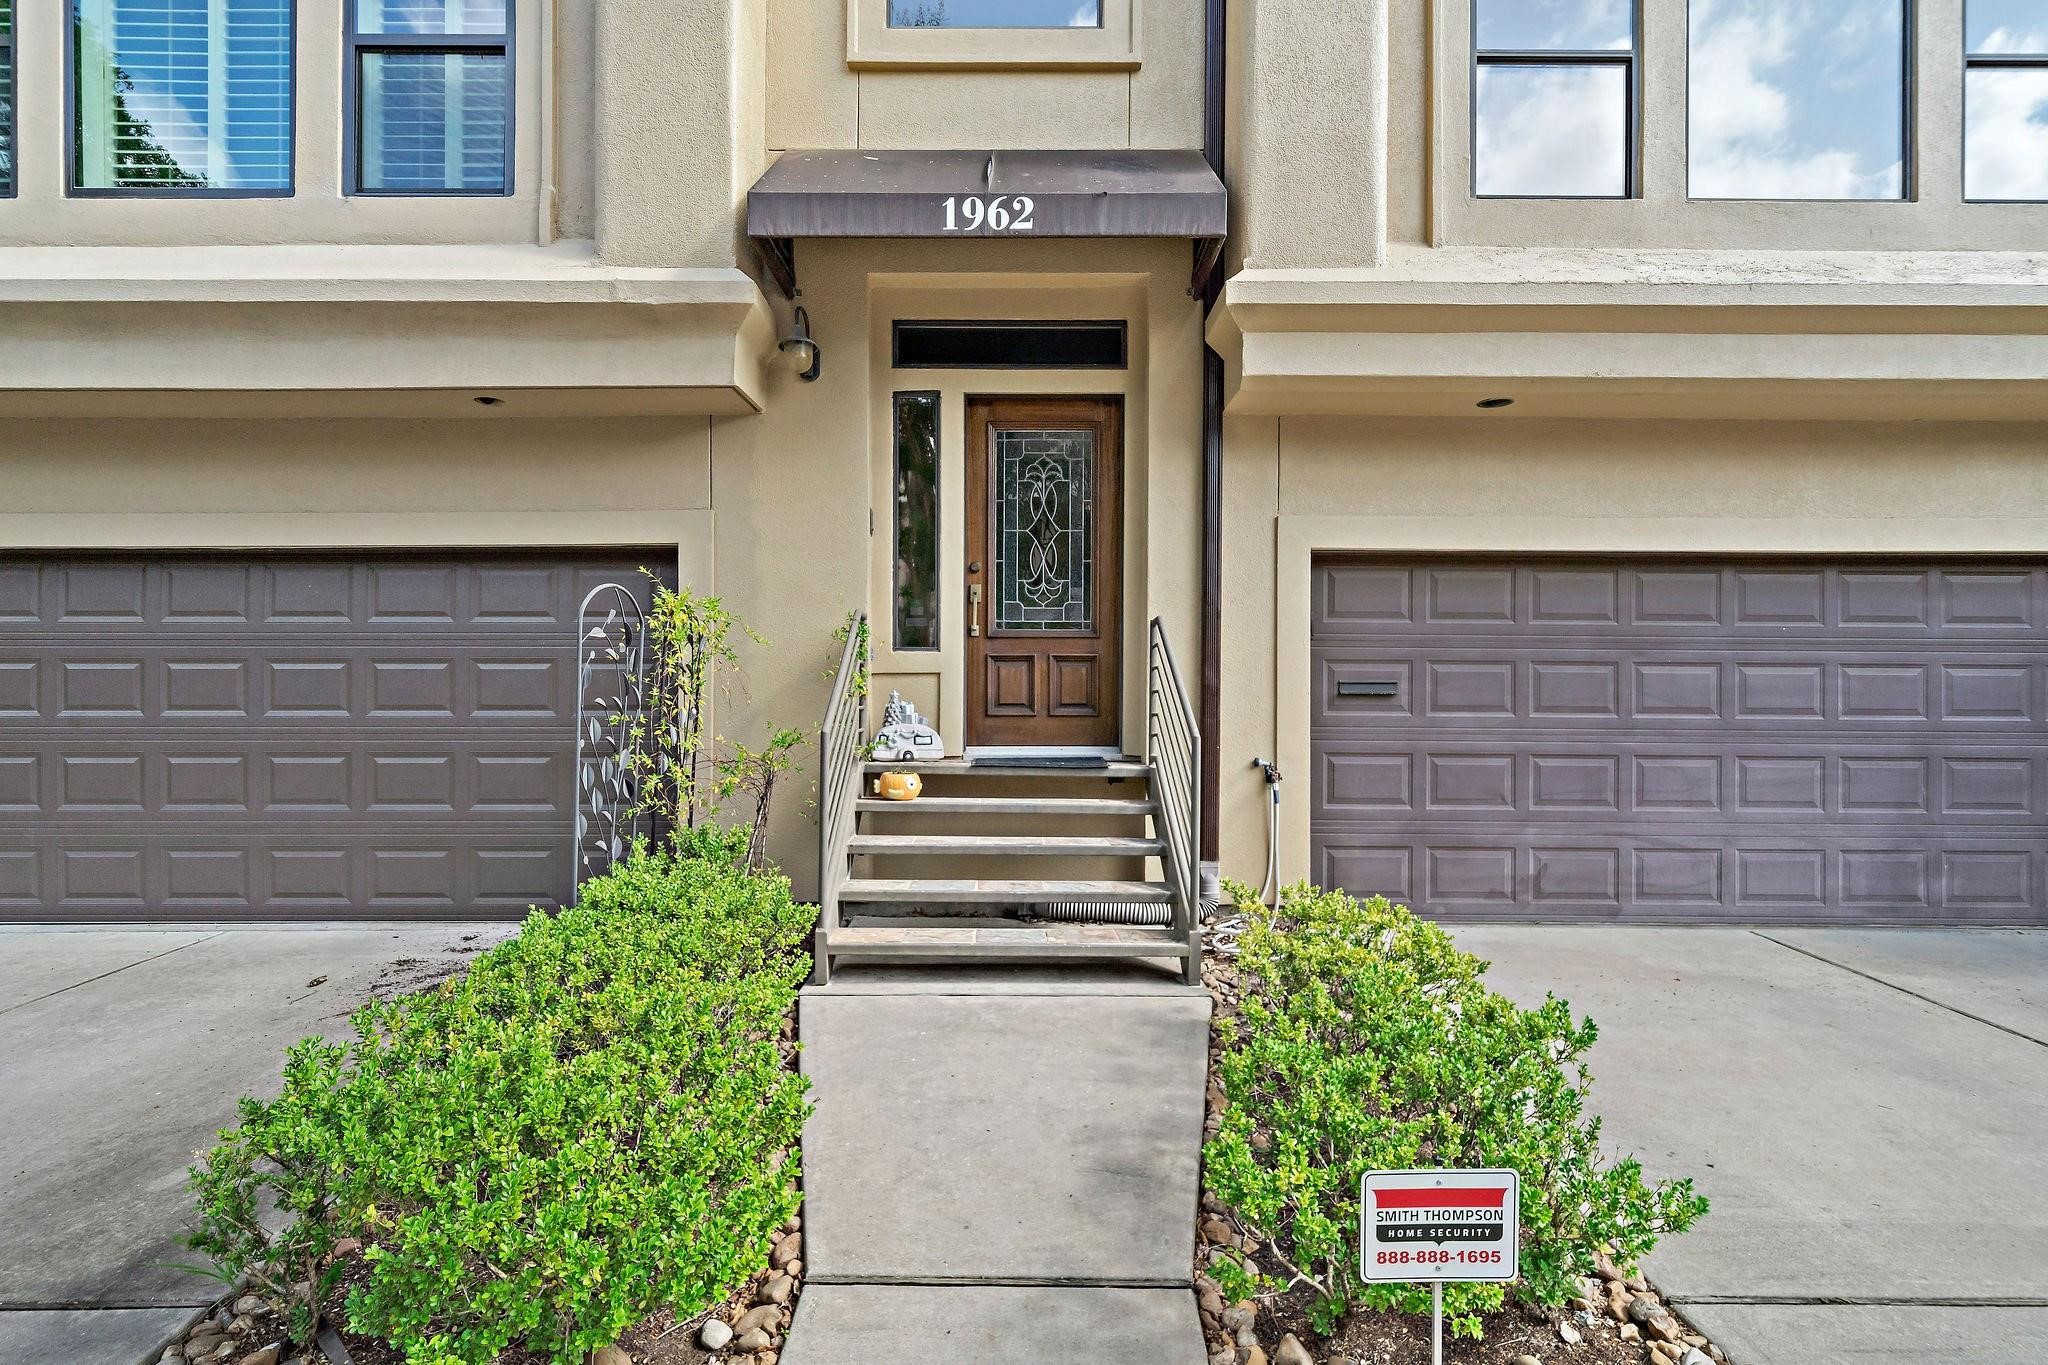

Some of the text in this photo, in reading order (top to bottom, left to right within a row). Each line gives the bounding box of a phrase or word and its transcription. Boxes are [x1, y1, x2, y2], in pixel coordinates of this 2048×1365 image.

[942, 196, 1034, 230] 1962
[1376, 1210, 1503, 1222] SMITH THOMPSON
[1388, 1228, 1491, 1238] HOME SECURITY
[1377, 1251, 1501, 1264] 888-888-1695
